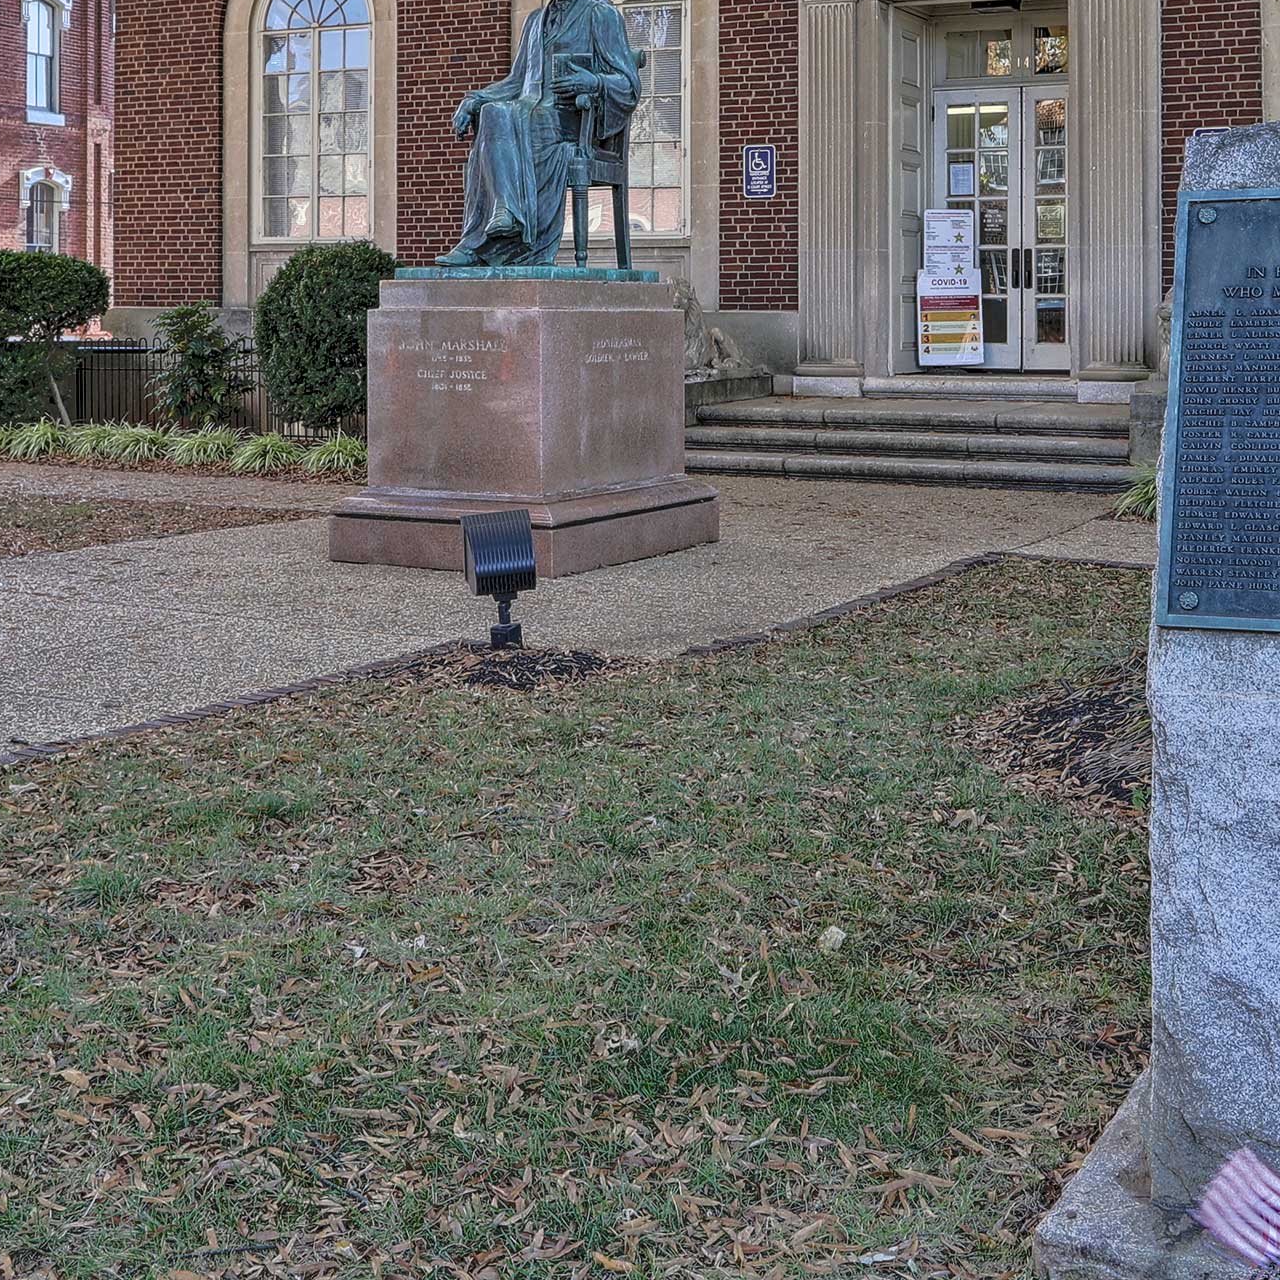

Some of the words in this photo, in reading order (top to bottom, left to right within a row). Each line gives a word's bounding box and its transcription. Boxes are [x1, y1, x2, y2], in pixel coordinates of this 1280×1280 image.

[1247, 265, 1265, 278] IN
[931, 278, 968, 286] COVID-19
[1223, 286, 1263, 299] WHO
[923, 324, 930, 332] 2
[923, 335, 929, 344] 3
[398, 340, 433, 351] JOHN
[441, 339, 508, 353] MARSHALL
[924, 346, 930, 354] 4
[1187, 343, 1228, 351] GEORGE
[417, 369, 445, 379] CHIEF
[449, 370, 487, 380] JUSTICE
[1182, 442, 1221, 450] CALVIN
[1178, 510, 1218, 518] GEORGE
[1224, 511, 1270, 520] EDWARD
[1178, 522, 1223, 530] EDWARD
